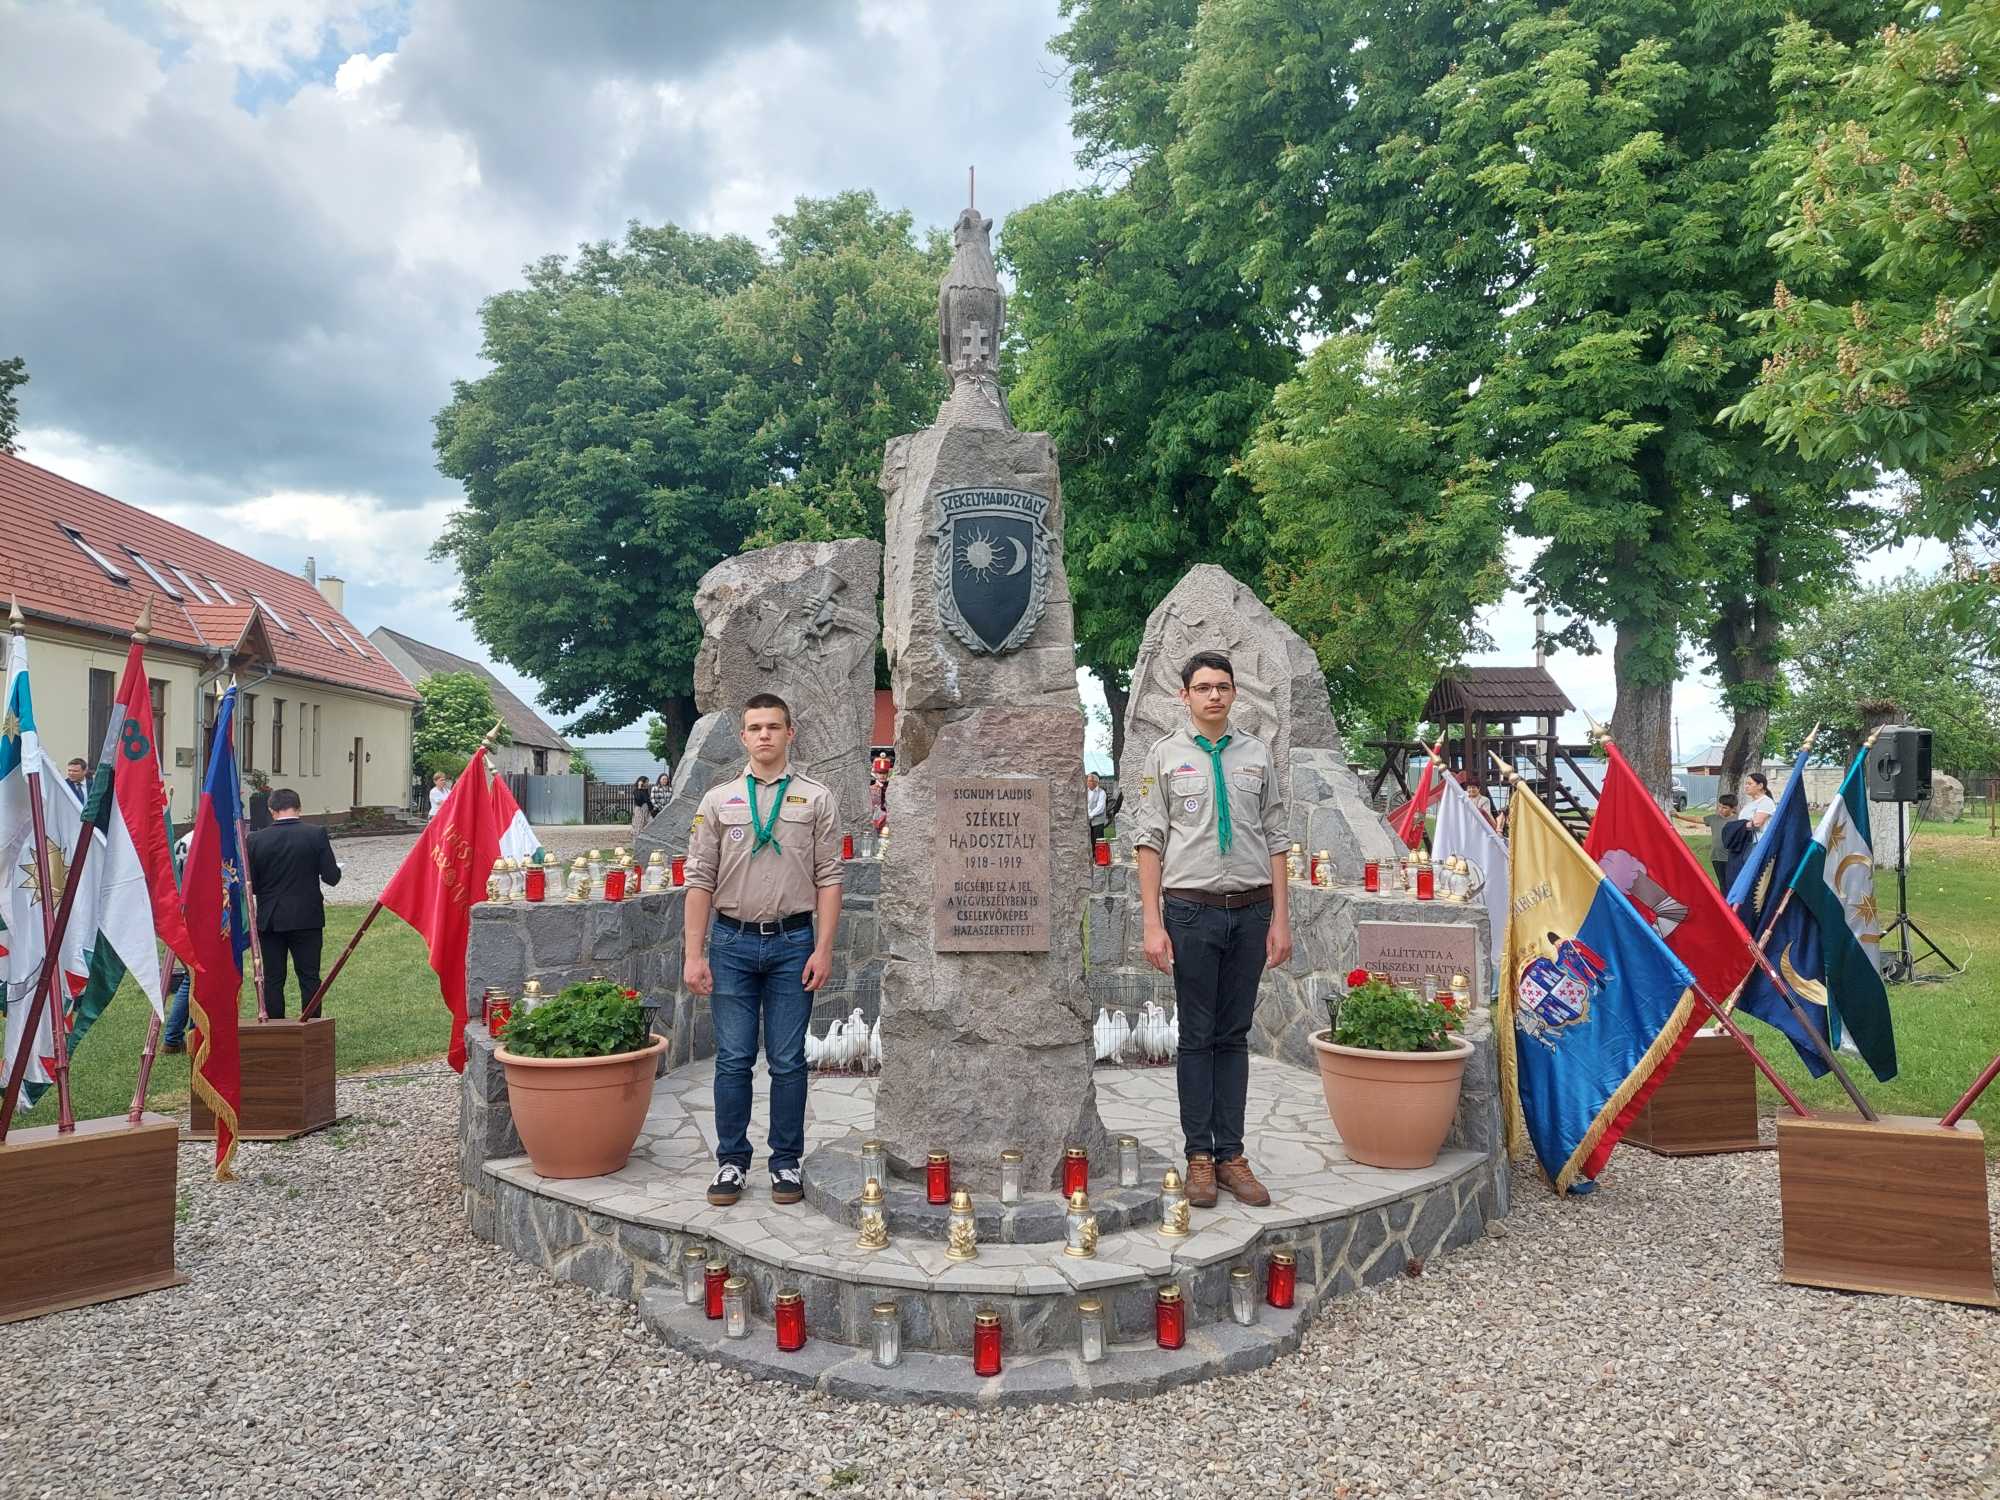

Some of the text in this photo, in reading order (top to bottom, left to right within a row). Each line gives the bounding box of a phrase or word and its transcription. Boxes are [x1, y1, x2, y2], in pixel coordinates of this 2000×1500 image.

[121, 718, 151, 761] 8
[953, 788, 1033, 801] SIGNUM LAUDIS
[965, 808, 1021, 827] SZÉKELY
[996, 881, 1008, 892] EZ
[1008, 881, 1016, 892] A
[1018, 881, 1033, 893] JEL
[947, 897, 955, 907] A
[1029, 895, 1038, 907] IS
[1445, 951, 1454, 961] A
